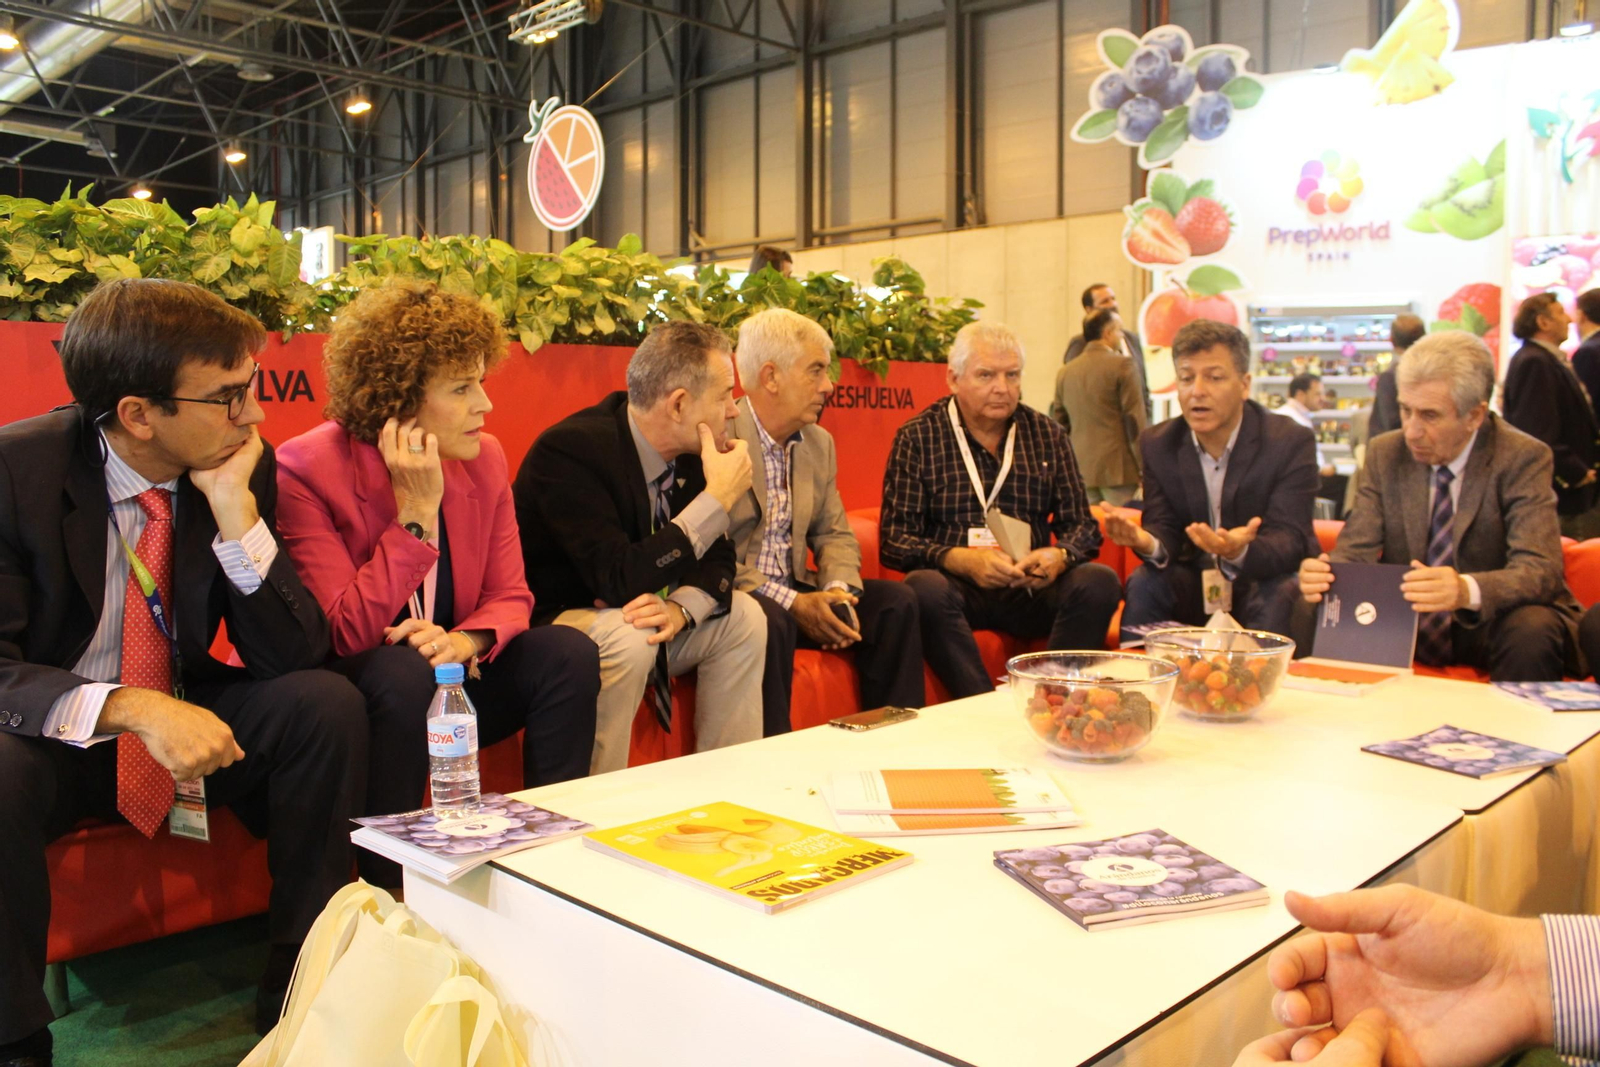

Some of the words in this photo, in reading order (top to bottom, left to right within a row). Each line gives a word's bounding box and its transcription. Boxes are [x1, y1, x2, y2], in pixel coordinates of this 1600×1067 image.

[1268, 220, 1390, 248] PrepWorld
[258, 369, 315, 402] LVA
[825, 385, 915, 409] RESHUELVA
[428, 732, 454, 744] ZOYA
[745, 848, 906, 902] MERCADOS
